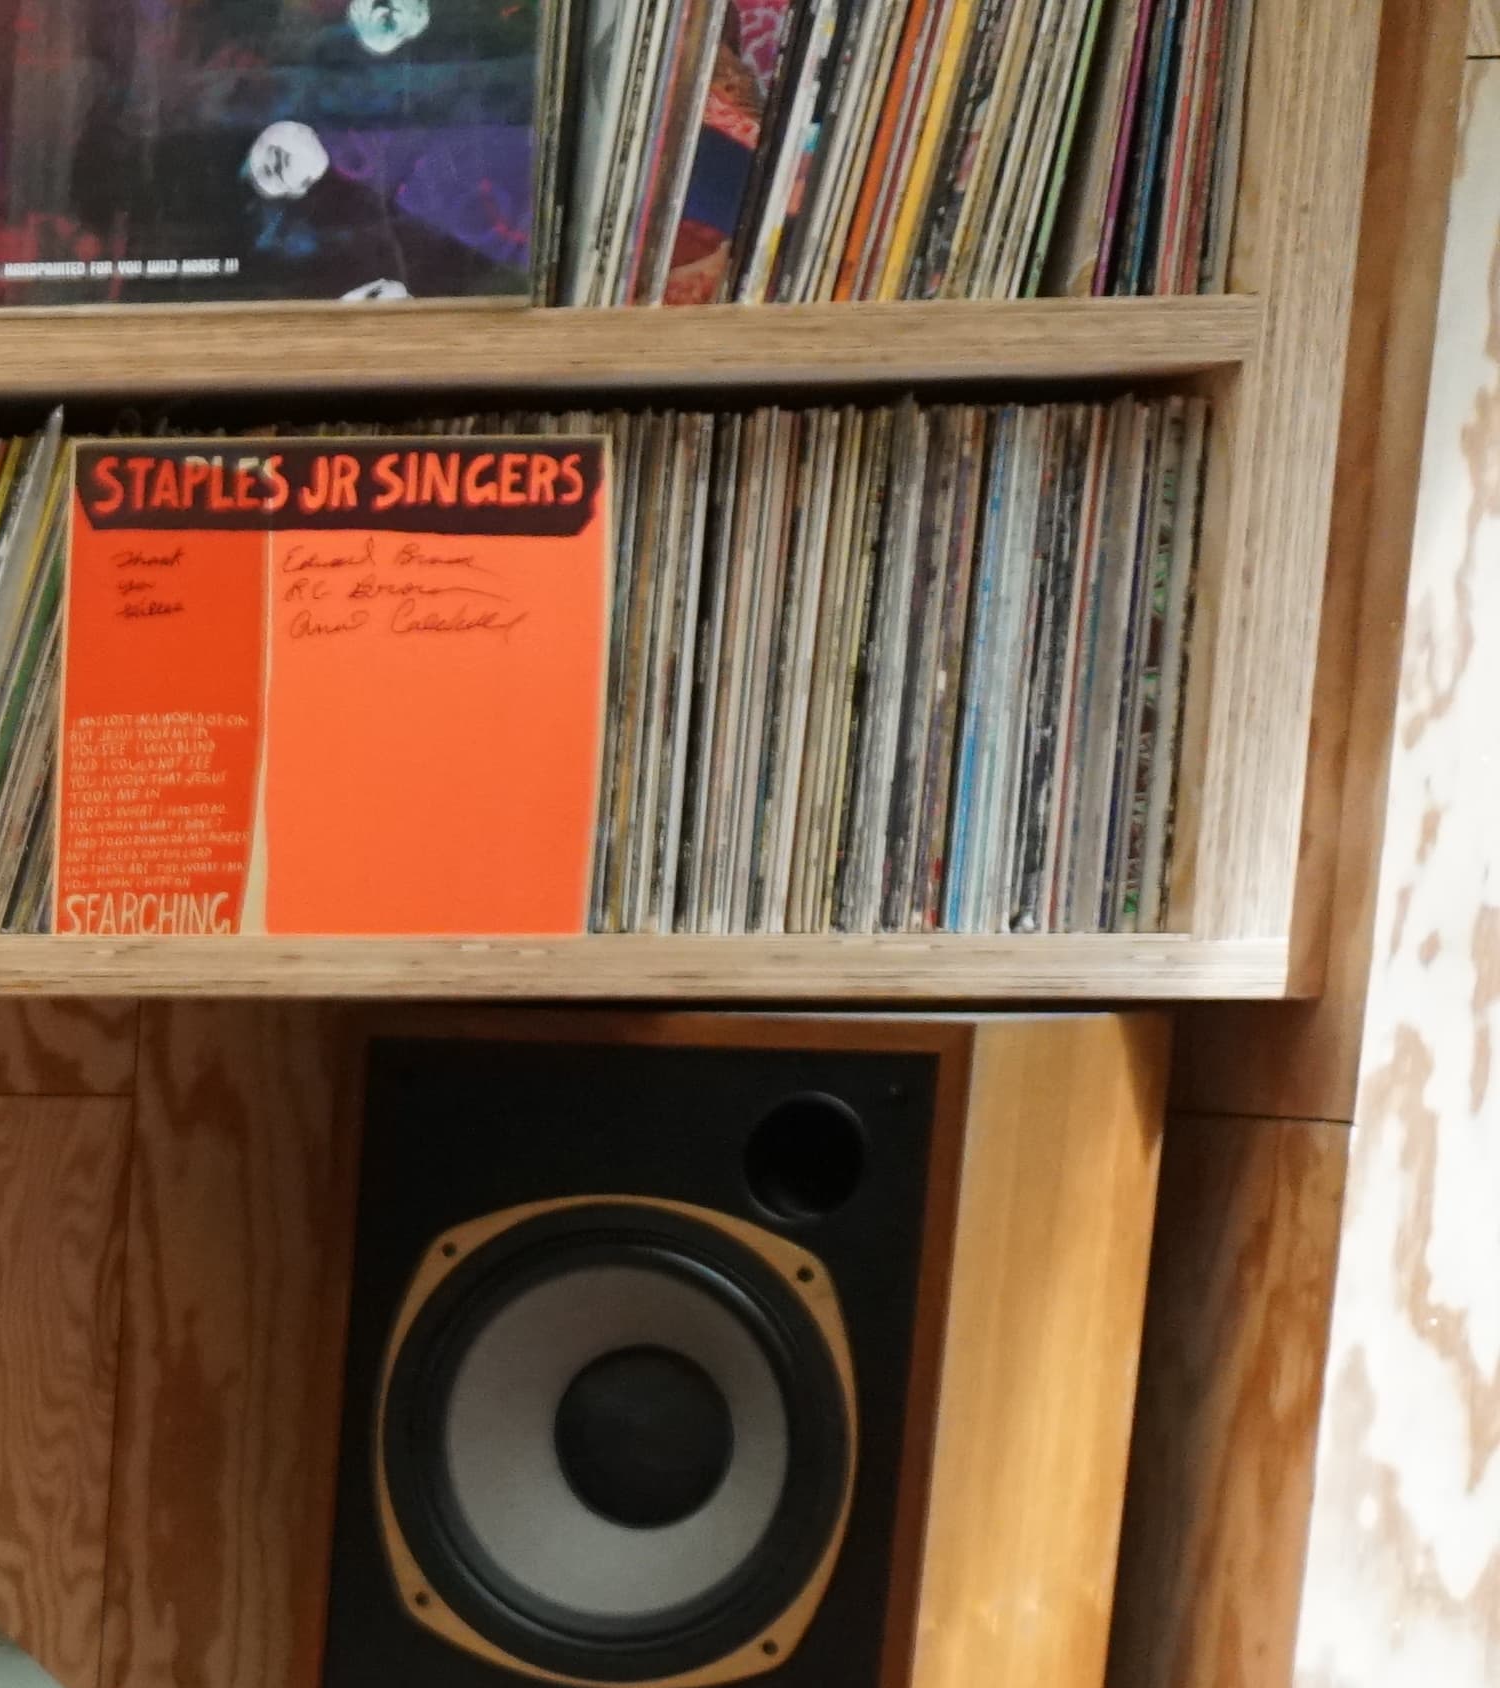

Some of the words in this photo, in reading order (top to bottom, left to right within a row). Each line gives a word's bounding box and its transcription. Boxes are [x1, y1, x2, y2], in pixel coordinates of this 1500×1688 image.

[90, 261, 112, 274] FOR
[118, 260, 142, 274] YOU
[147, 260, 177, 274] WILD
[93, 454, 290, 514] STAPLES
[301, 453, 361, 510] JR
[372, 452, 584, 508] SINGERS
[62, 891, 232, 936] SEARCHING
